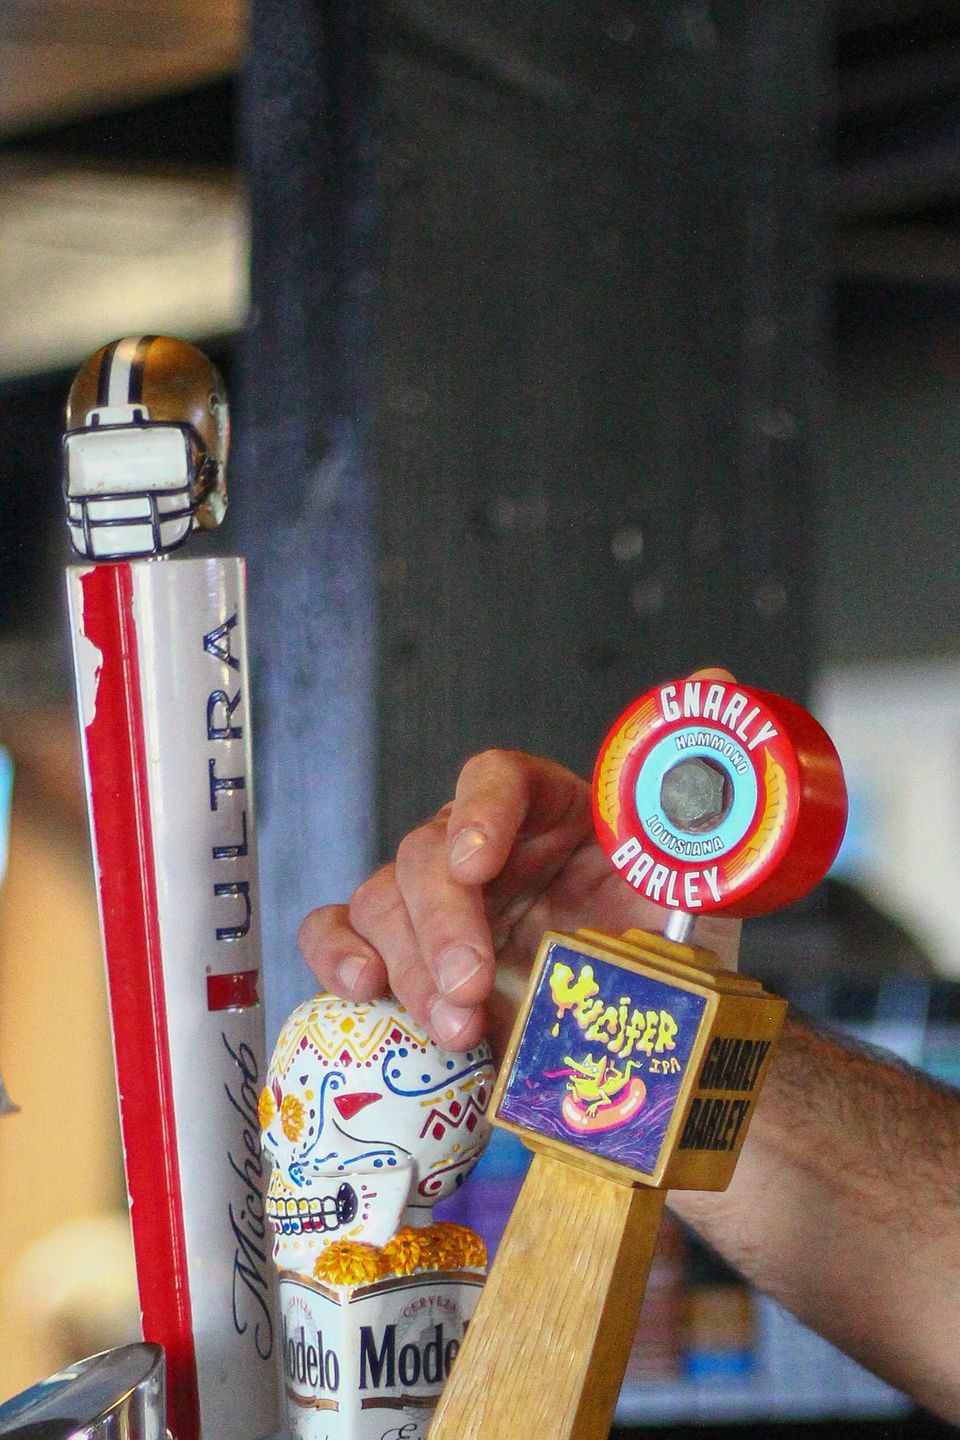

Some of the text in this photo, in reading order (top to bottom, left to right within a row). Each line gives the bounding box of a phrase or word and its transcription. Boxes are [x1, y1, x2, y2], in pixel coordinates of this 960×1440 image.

[660, 682, 778, 751] GNARLY
[675, 731, 749, 776] HAMMOND
[646, 815, 724, 856] LOUISIANA
[611, 836, 722, 908] BARLEY
[203, 609, 272, 1361] Michelob ULTRA
[649, 1057, 681, 1075] IPA
[700, 1036, 771, 1091] GNARLY
[679, 1098, 752, 1150] BARLEY
[359, 1319, 470, 1391] Mode
